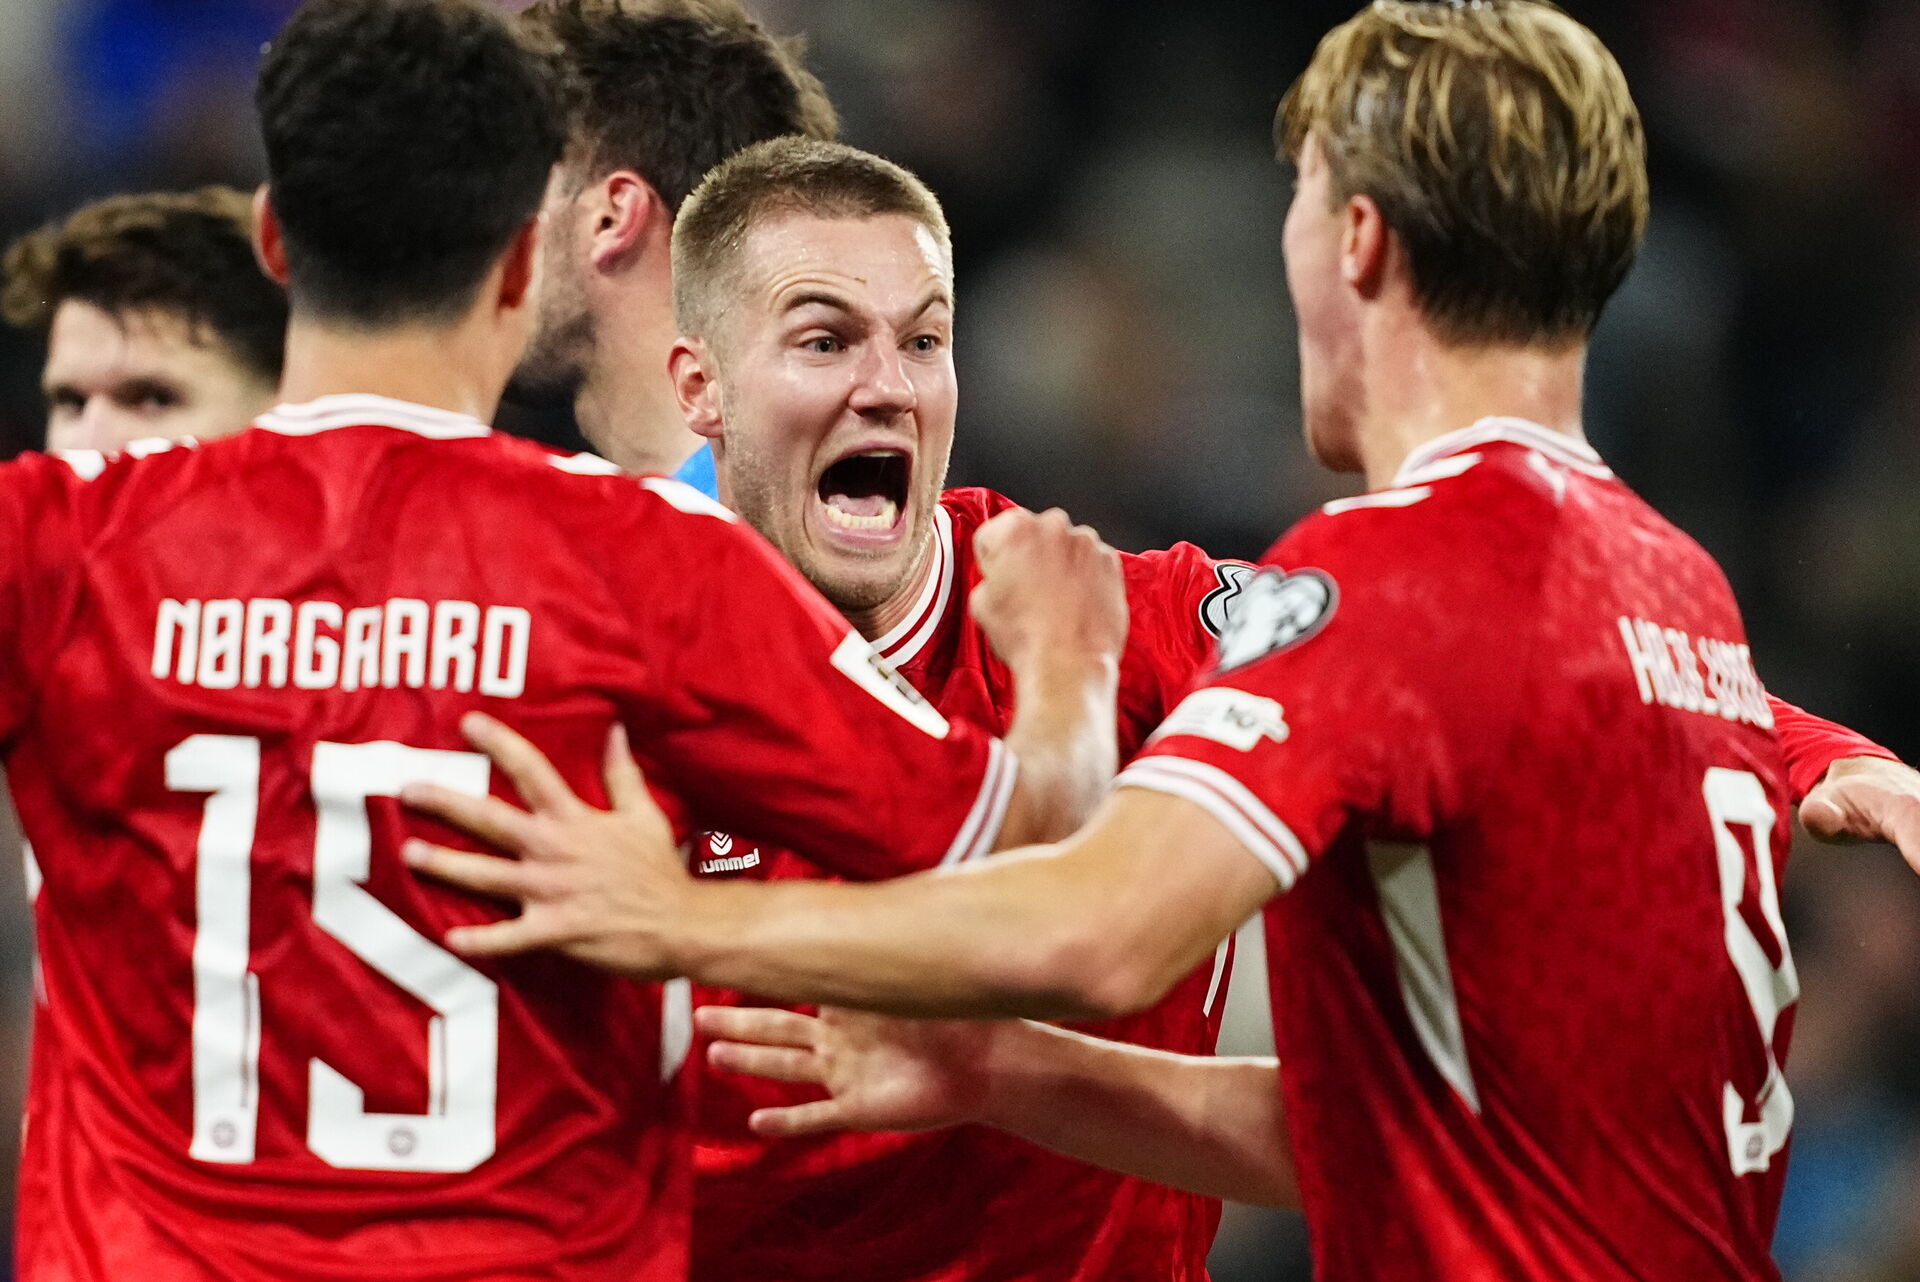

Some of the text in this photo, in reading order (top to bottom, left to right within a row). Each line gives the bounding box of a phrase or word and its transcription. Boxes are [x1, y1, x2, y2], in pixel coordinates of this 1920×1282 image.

[151, 597, 531, 698] NØRGAARD
[165, 734, 499, 1173] 15
[1702, 766, 1799, 1177] 9
